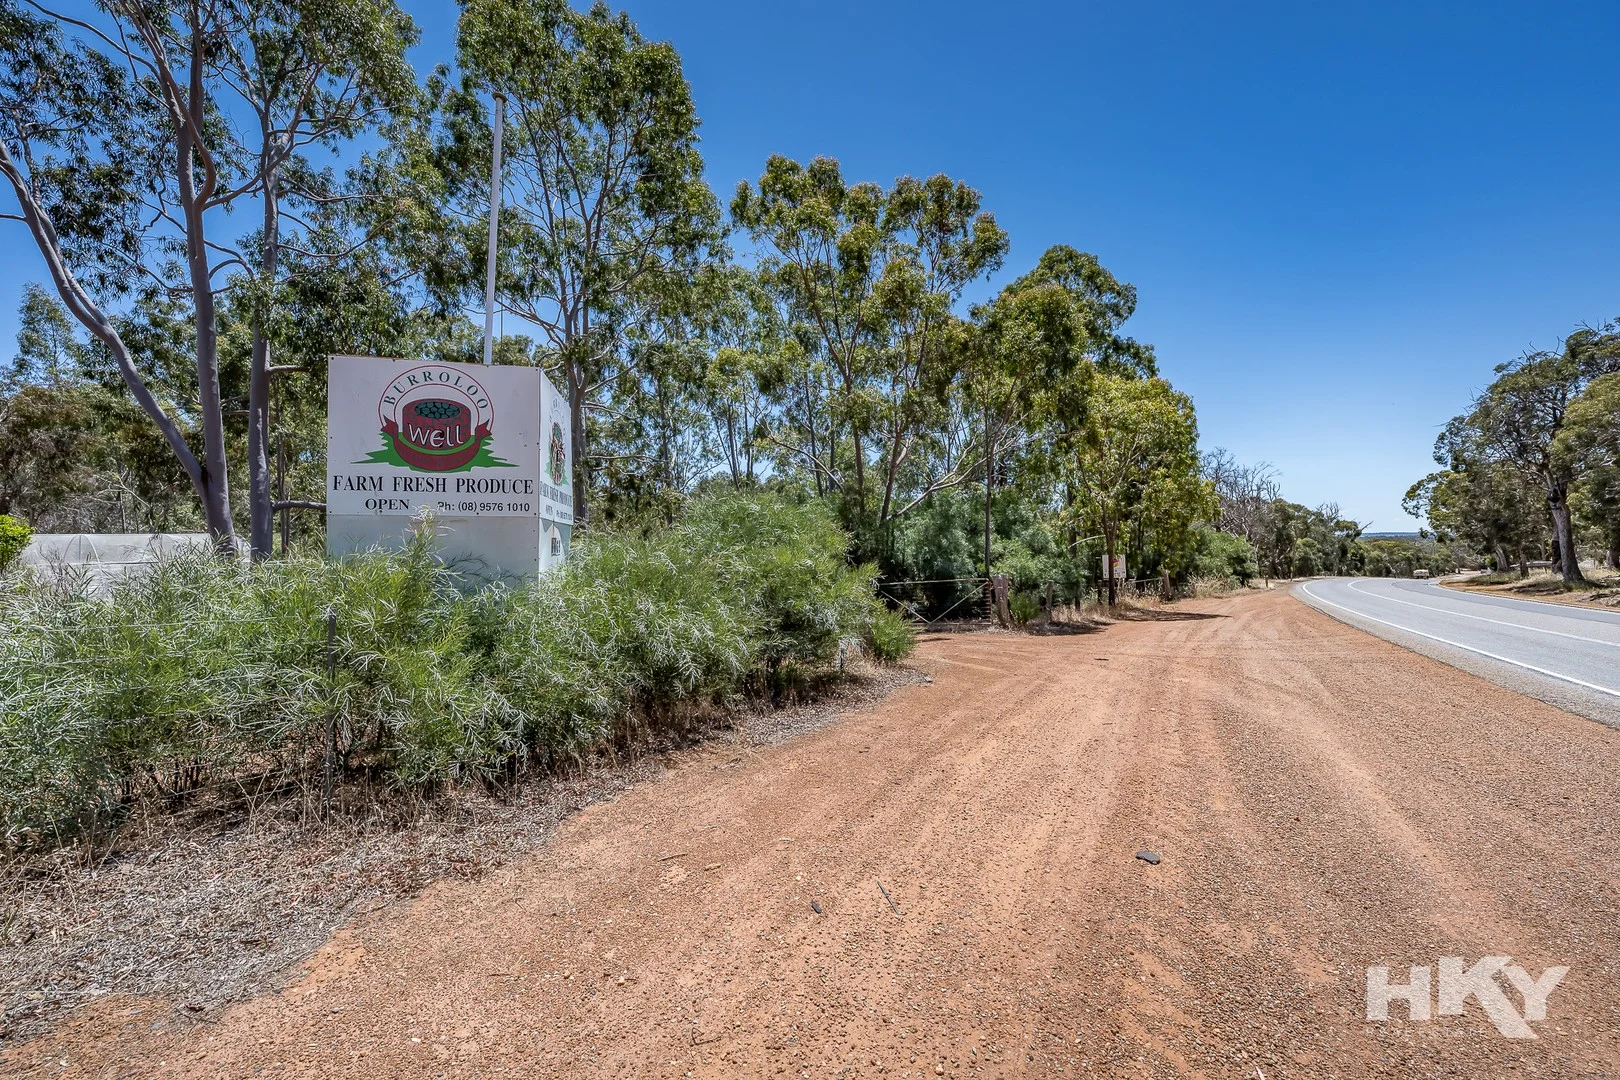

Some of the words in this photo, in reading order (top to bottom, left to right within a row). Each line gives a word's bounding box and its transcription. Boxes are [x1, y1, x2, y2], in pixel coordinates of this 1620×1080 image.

[383, 371, 489, 409] BURROLOO
[333, 476, 383, 492] FARM
[393, 477, 448, 493] FRESH
[456, 478, 534, 495] PRODUCE
[365, 498, 410, 511] OPEN
[437, 501, 454, 511] Ph:
[458, 501, 477, 513] (08)
[480, 502, 503, 512] 9576
[507, 503, 530, 512] 1010
